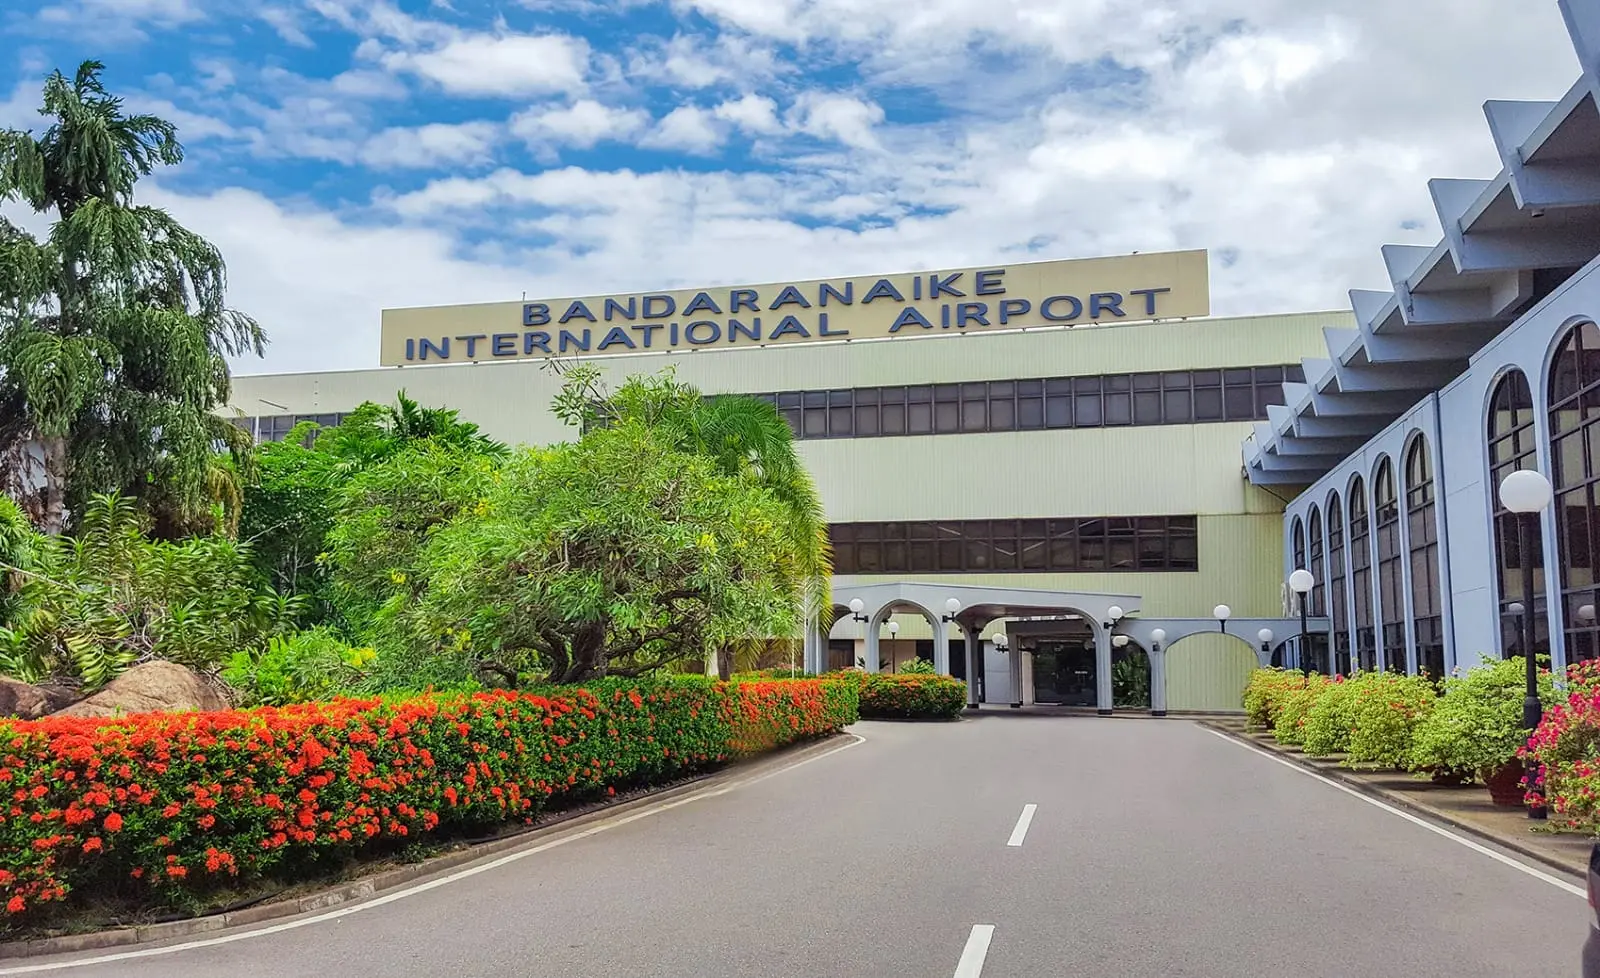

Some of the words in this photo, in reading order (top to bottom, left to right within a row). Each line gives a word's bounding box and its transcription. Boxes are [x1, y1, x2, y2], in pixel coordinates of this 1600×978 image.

[405, 313, 849, 361] INTERNATIONAL
[888, 287, 1171, 333] AIRPORT
[522, 268, 1007, 327] BANDARANAIKE
